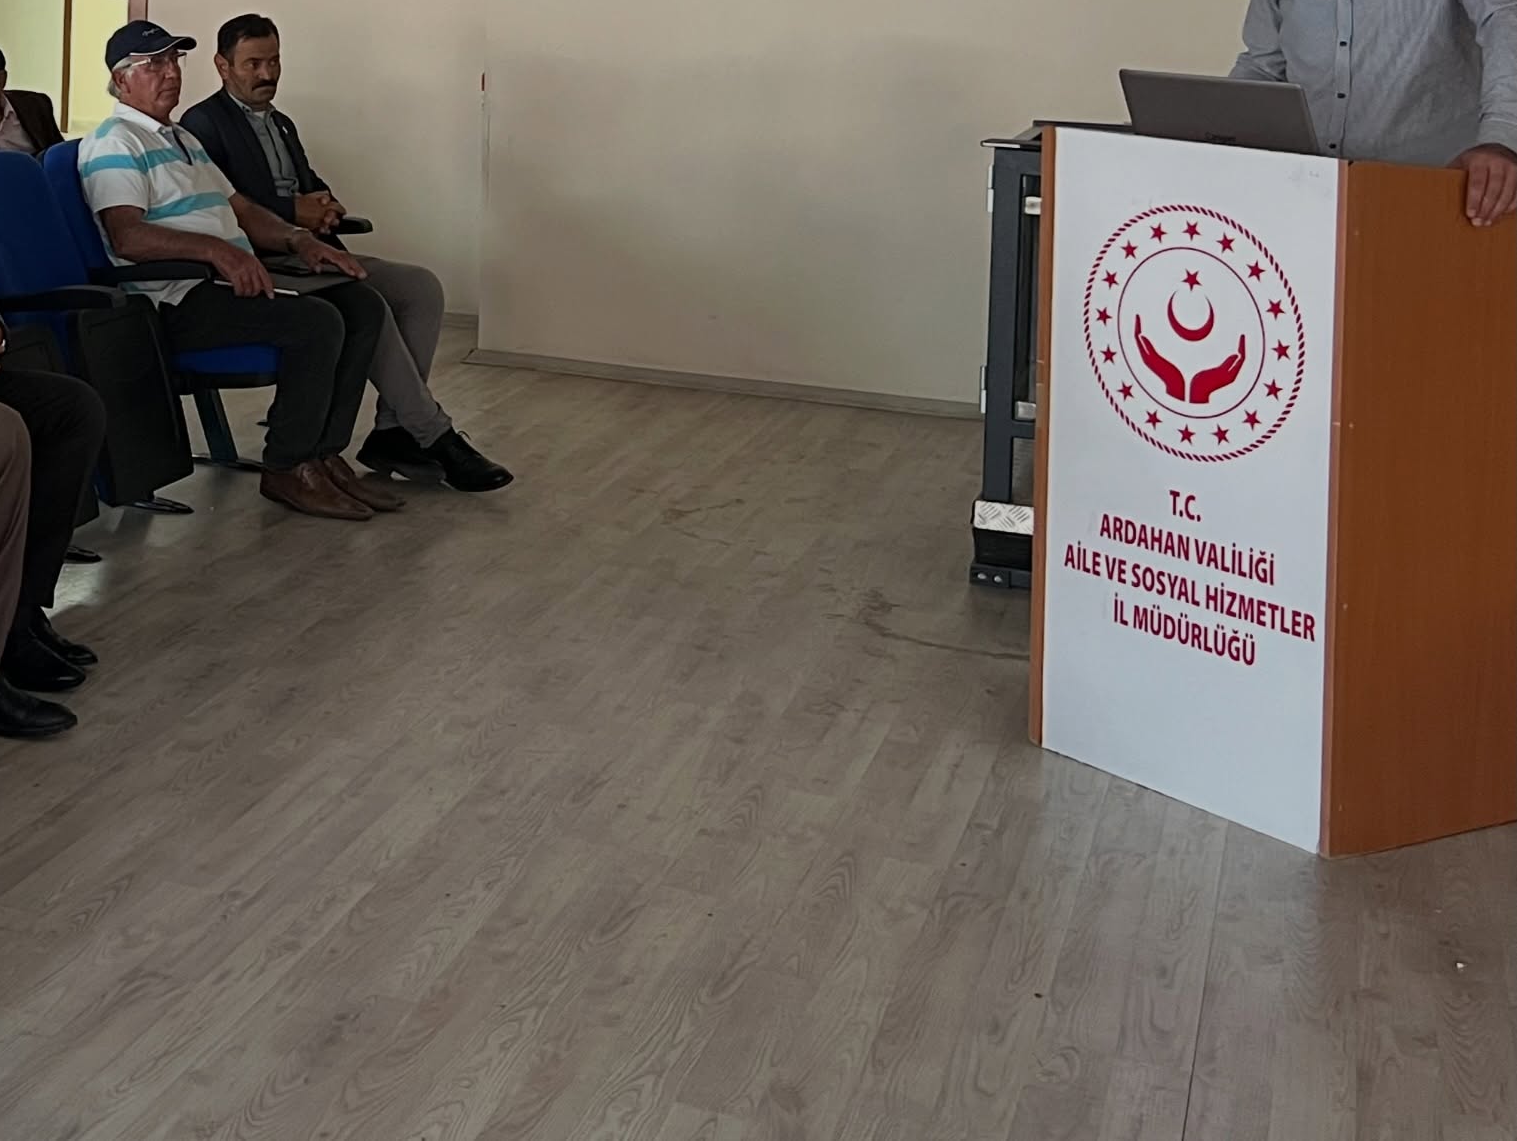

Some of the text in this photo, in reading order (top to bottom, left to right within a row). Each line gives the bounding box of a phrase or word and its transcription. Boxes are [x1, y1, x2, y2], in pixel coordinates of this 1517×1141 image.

[1169, 489, 1201, 522] T.C.
[1099, 513, 1275, 586] ARDAHAN VALİLİĞİ
[1064, 540, 1316, 642] AİLE VE SOSYAL HİZMETLER
[1113, 592, 1256, 665] İL MÜDÜRLÜĞÜ
